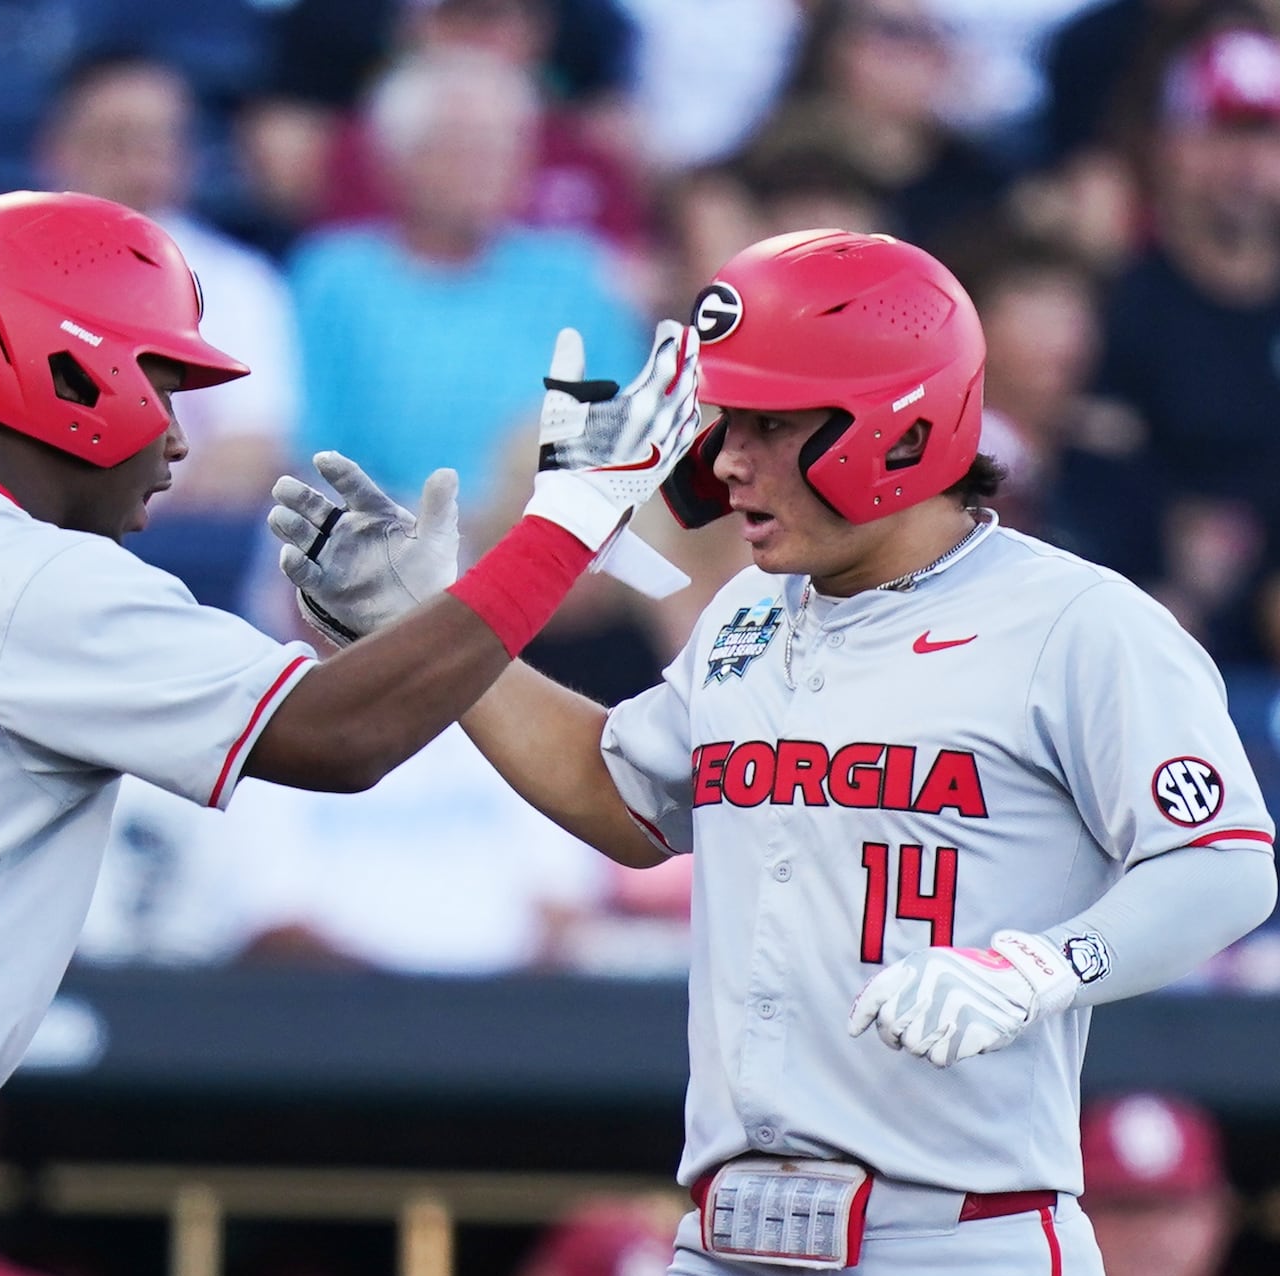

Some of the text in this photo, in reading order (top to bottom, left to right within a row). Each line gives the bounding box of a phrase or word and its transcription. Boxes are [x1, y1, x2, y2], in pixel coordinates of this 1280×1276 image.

[60, 319, 103, 347] marucci
[689, 282, 741, 342] G
[692, 739, 989, 818] EORGIA
[1157, 760, 1221, 823] SEC
[860, 841, 959, 964] 14
